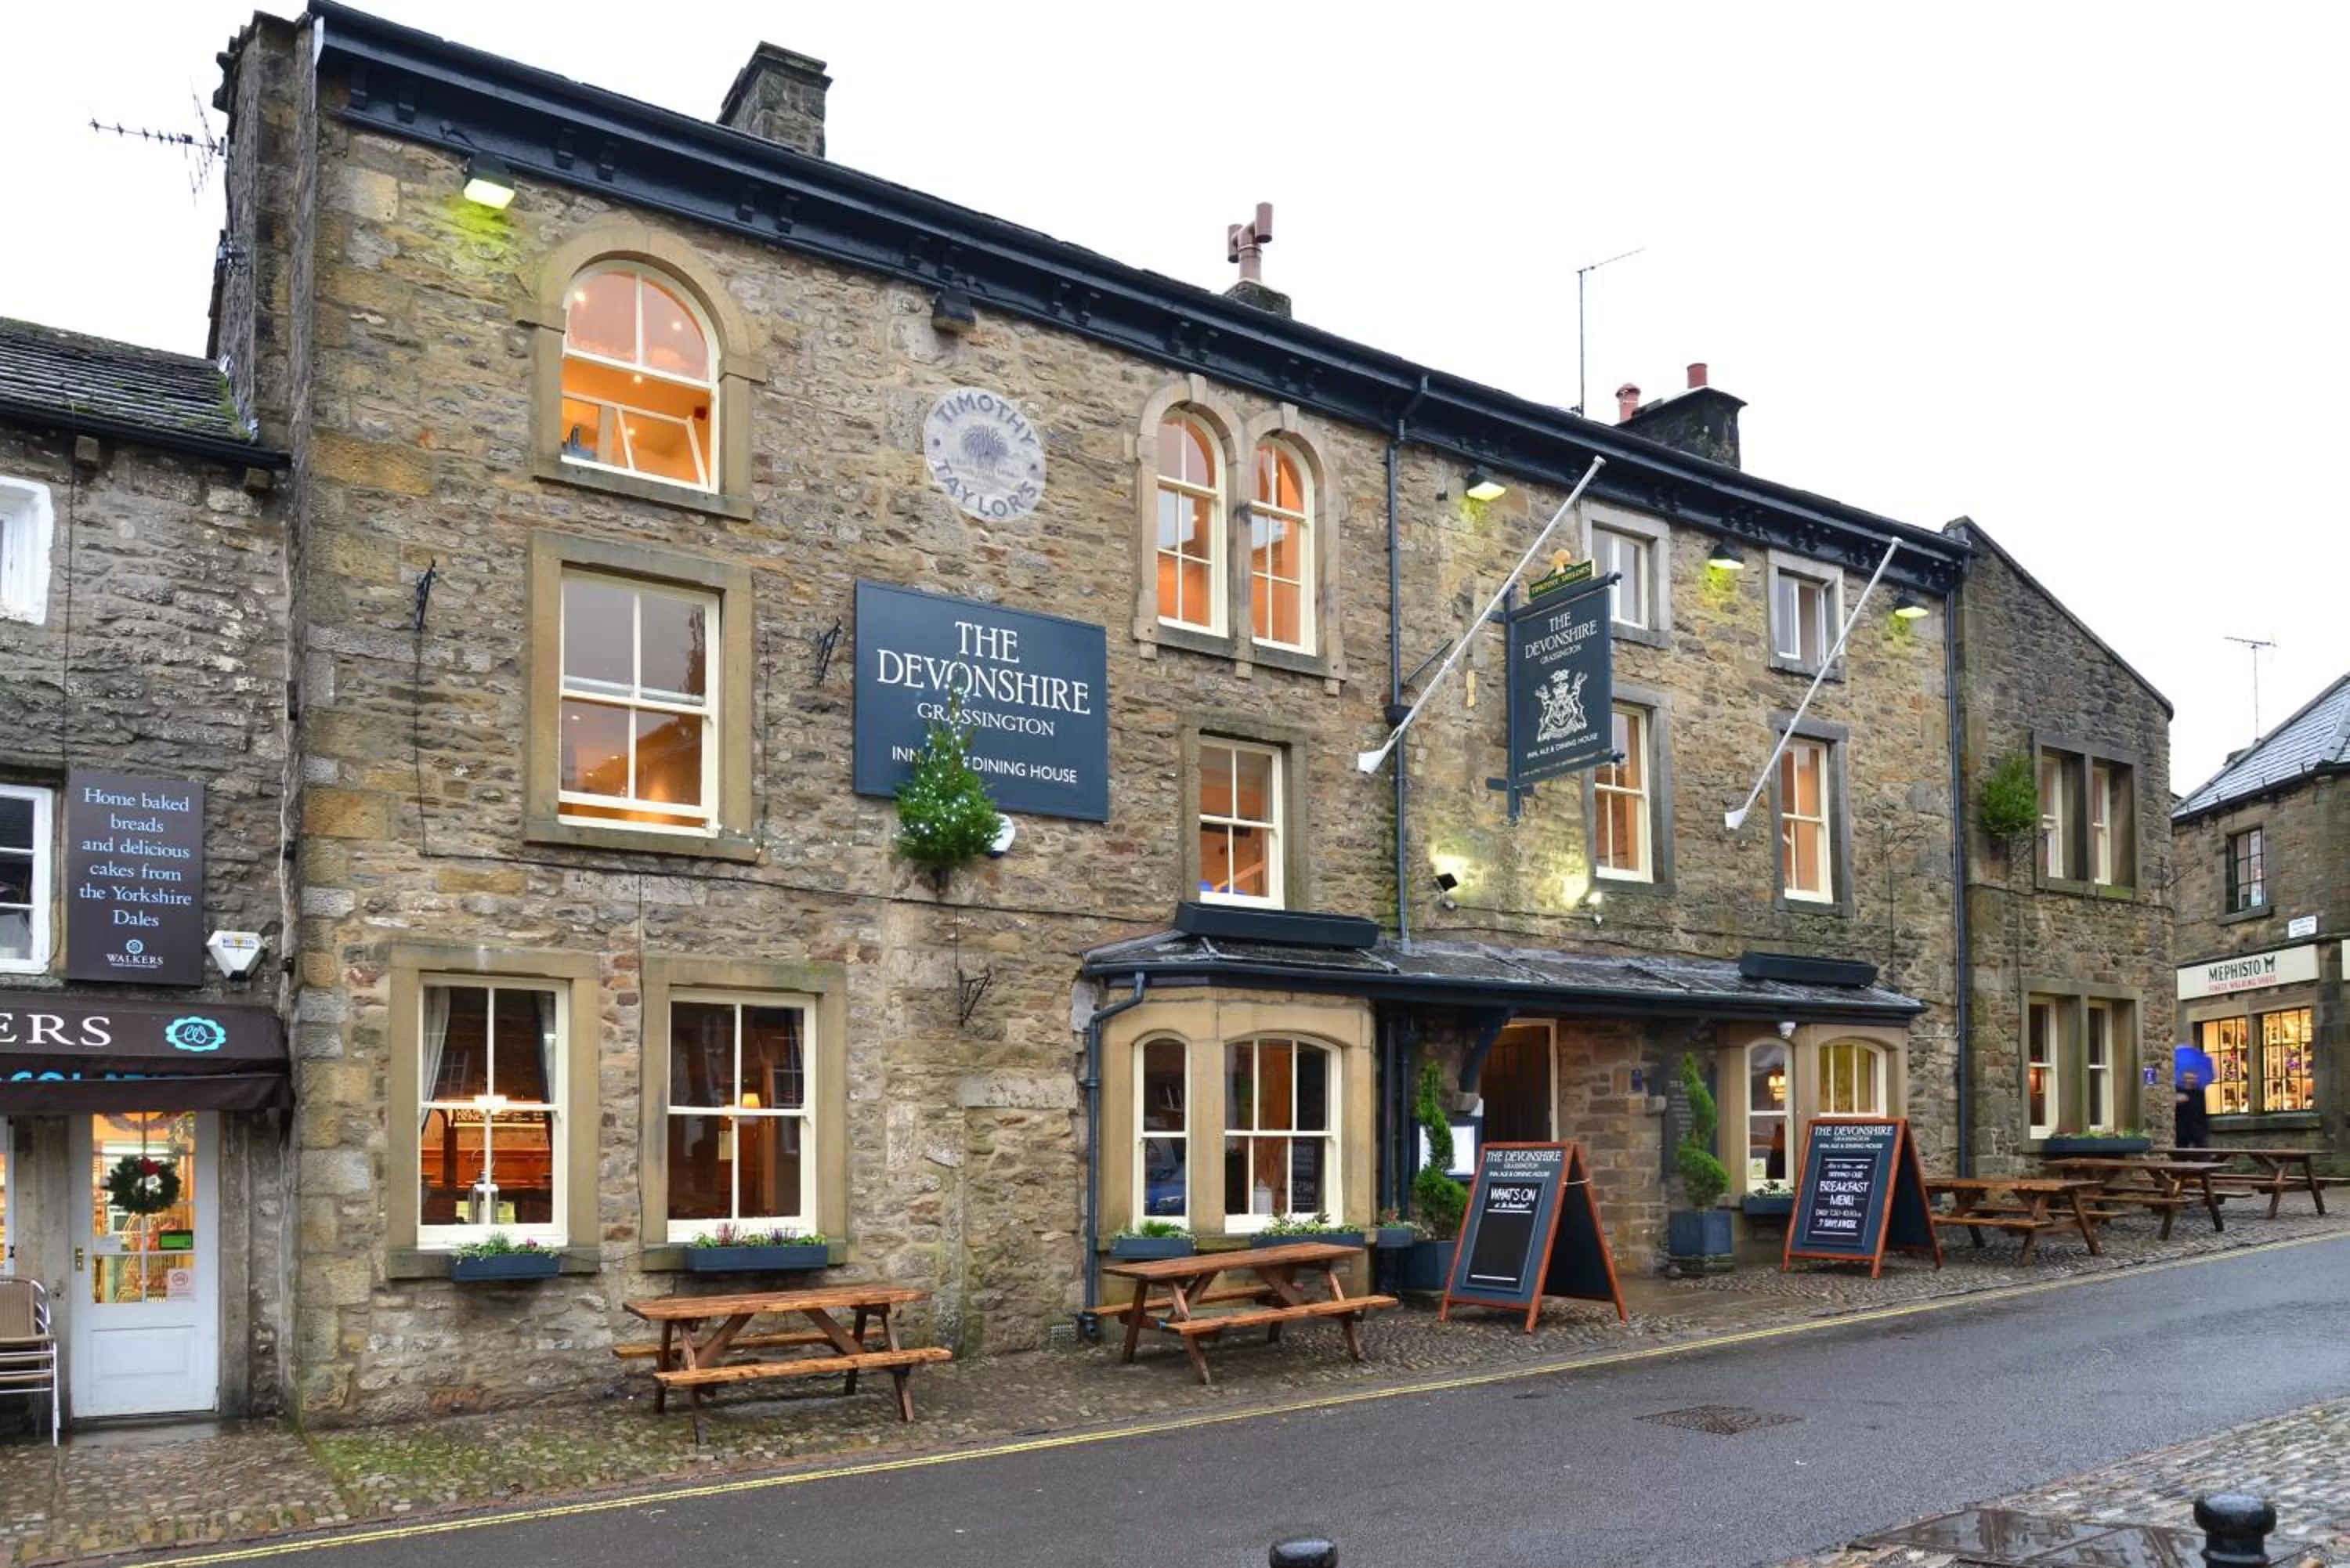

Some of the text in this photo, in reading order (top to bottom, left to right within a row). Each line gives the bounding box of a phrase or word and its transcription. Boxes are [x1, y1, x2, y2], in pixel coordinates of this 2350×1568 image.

[934, 393, 1036, 445] TIMOTHY
[1549, 612, 1572, 632] THE
[955, 621, 1020, 663] THE
[1525, 620, 1598, 659] DEVONSHIRE
[877, 649, 1091, 715] DEVONSHIRE
[917, 703, 1055, 736] GRSSINGTON
[1578, 732, 1597, 744] HOUSE
[973, 757, 1025, 777] DINING
[1030, 764, 1078, 783] HOUSE
[83, 787, 190, 812] Home baked
[110, 812, 164, 833] breads
[81, 836, 190, 859] and delicious
[89, 861, 182, 881] cakes from
[79, 883, 192, 905] the Yorkshire
[113, 909, 160, 927] Dales
[106, 953, 164, 965] WALKERS
[2209, 959, 2261, 983] MEPHISTO
[1814, 1125, 1893, 1136] THE DEVONSHIRE
[1486, 1150, 1562, 1163] THE DEVONSHIRE
[1491, 1187, 1537, 1201] WHAT'S ON
[1819, 1180, 1869, 1193] BREAKFAST
[1829, 1194, 1854, 1206] MENU
